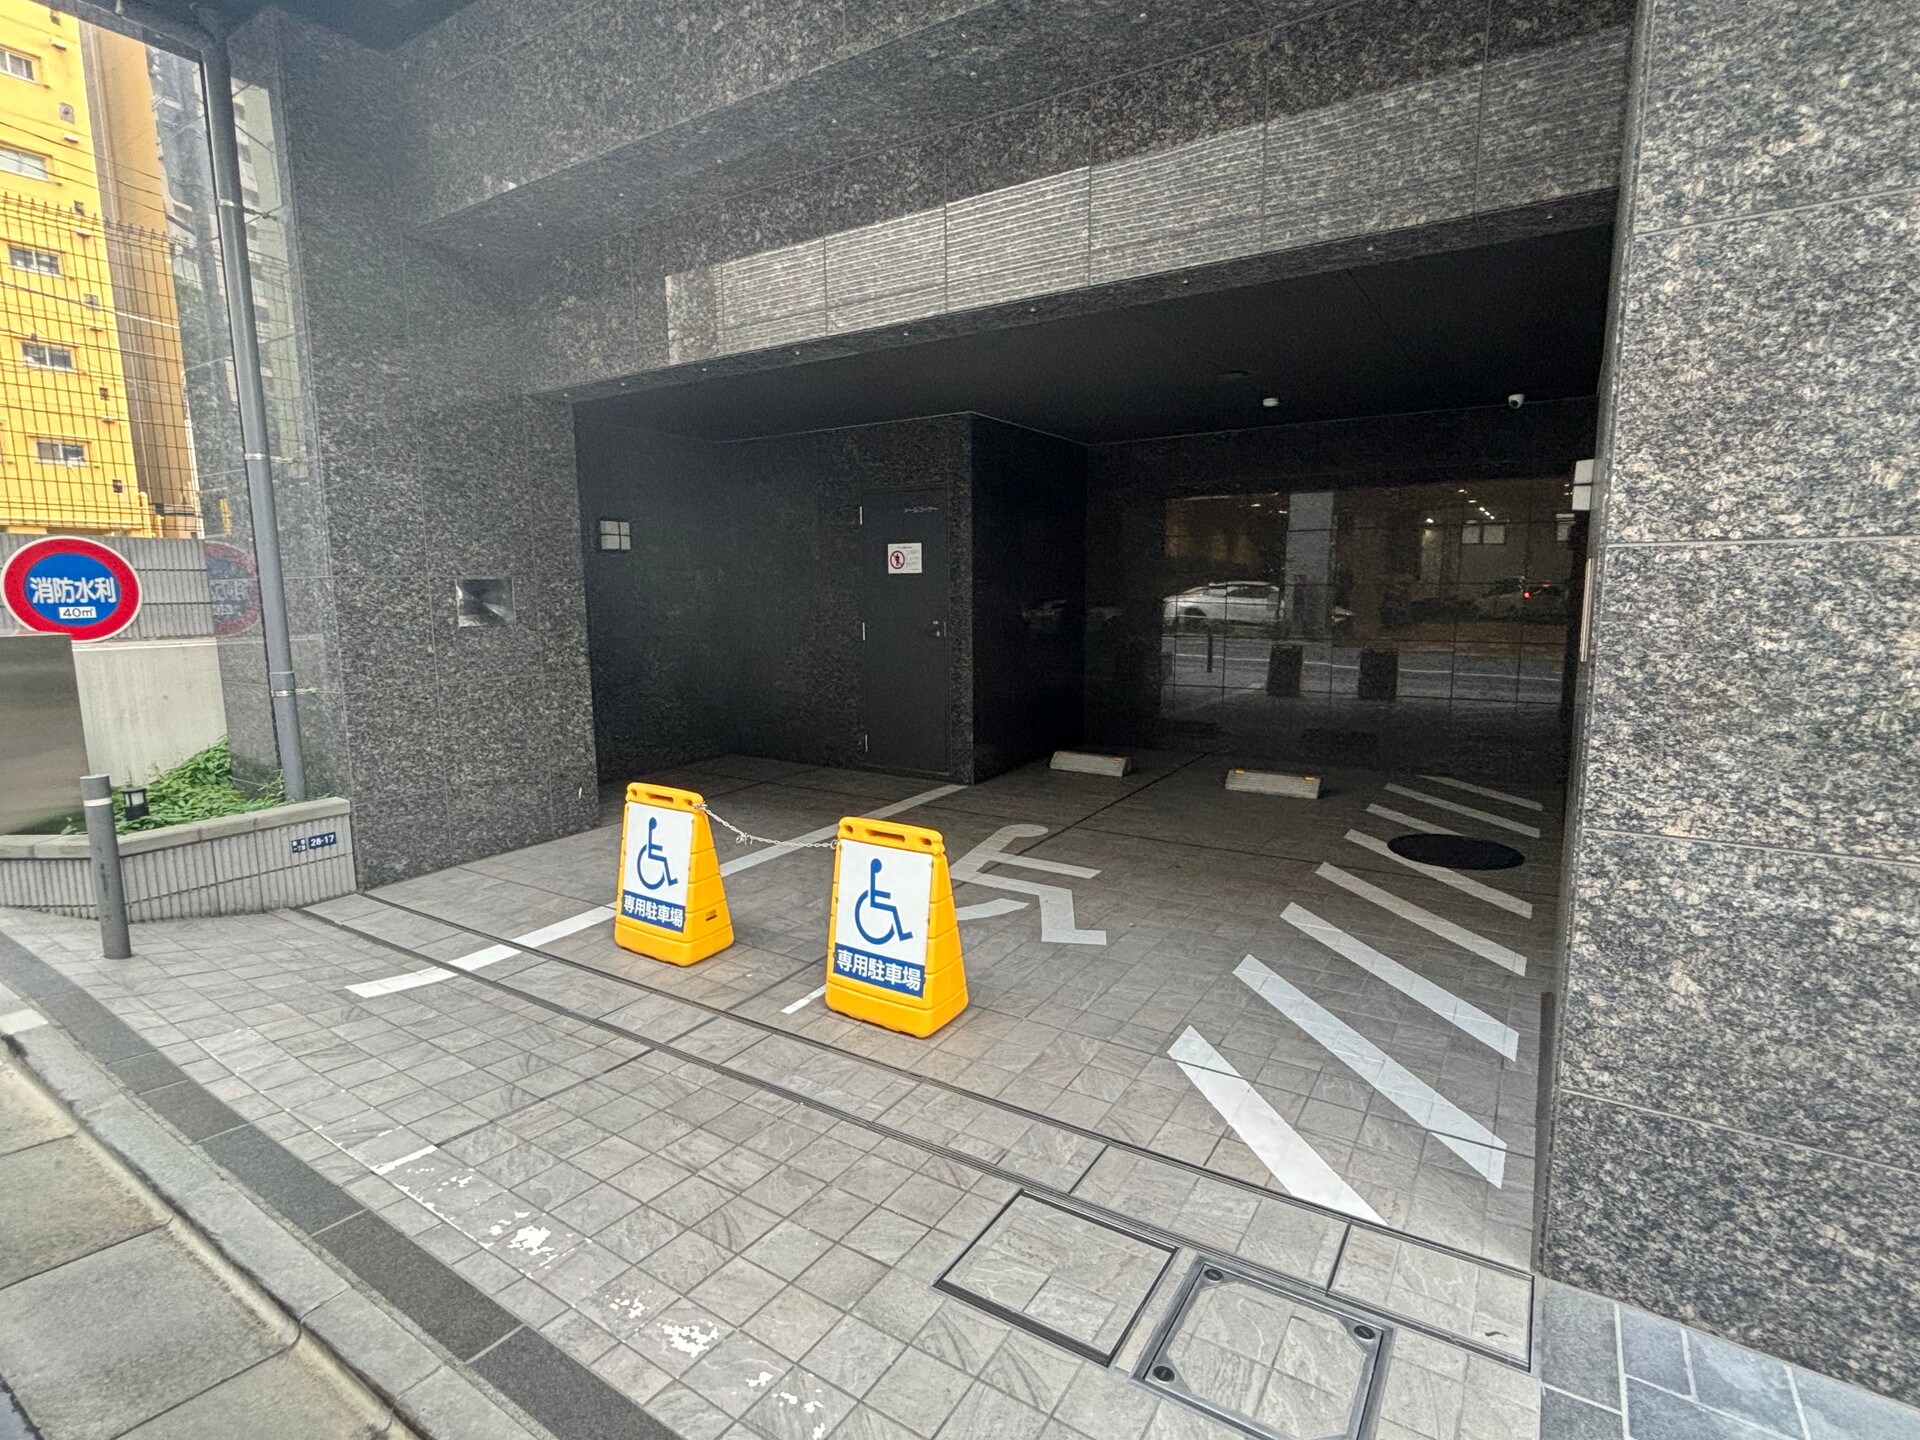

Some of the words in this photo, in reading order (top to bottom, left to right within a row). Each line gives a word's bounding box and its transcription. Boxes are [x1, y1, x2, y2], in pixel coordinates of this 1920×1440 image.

[30, 577, 117, 603] 消防水利
[310, 834, 335, 847] 28-17
[624, 894, 684, 928] 専用駐車場
[837, 949, 921, 992] 専用駐車場
